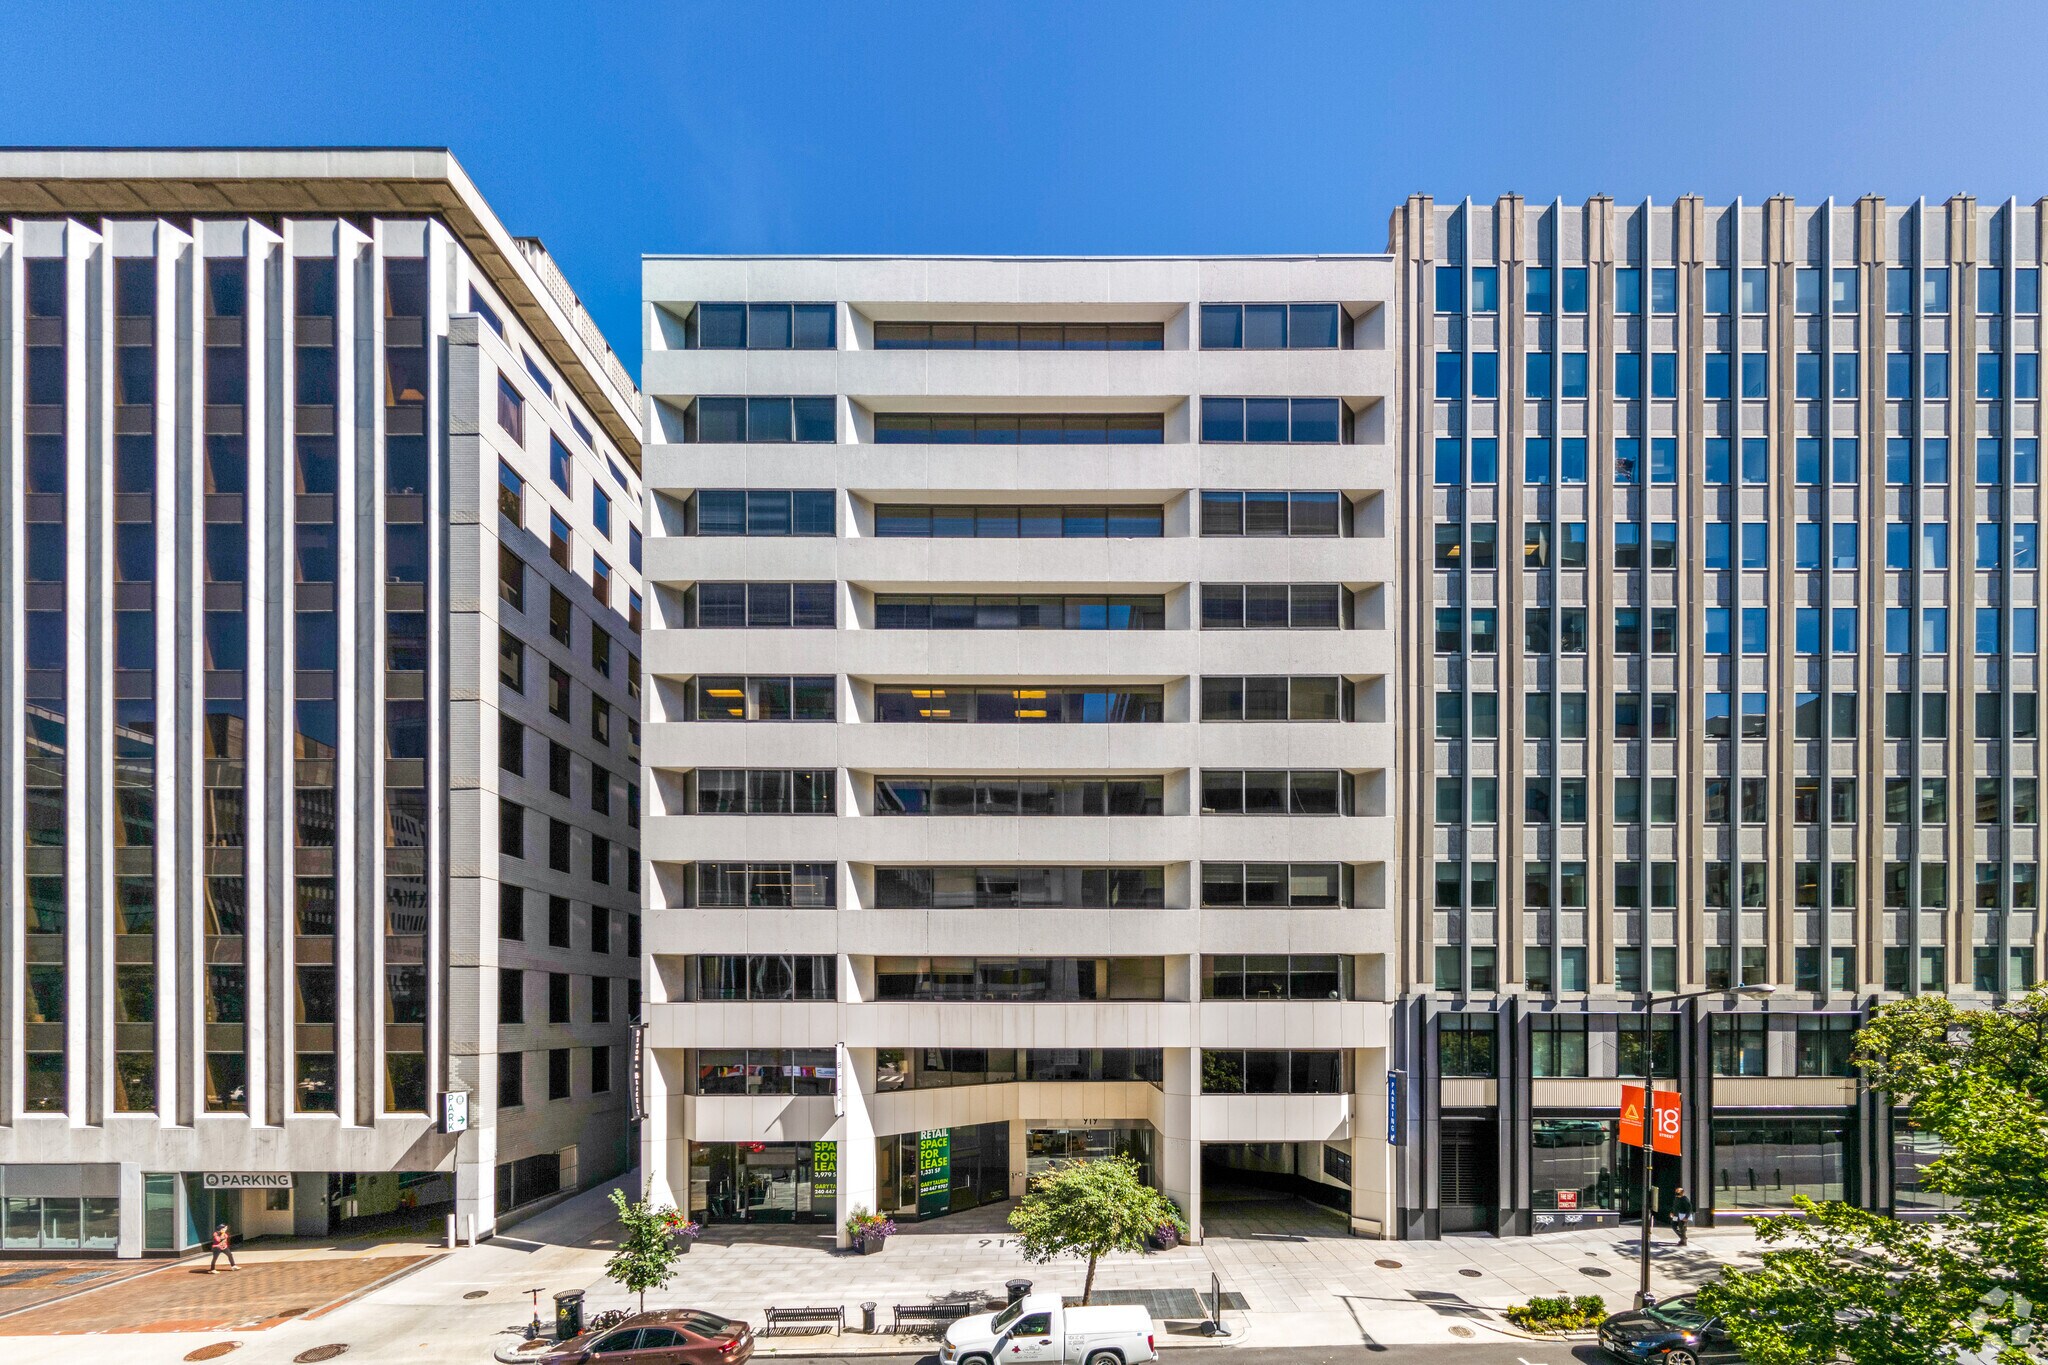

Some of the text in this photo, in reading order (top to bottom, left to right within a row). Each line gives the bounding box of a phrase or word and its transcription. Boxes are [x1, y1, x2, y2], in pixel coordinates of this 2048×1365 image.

[1654, 1108, 1679, 1134] 18
[920, 1128, 949, 1140] RETAIL
[920, 1138, 948, 1150] SPACE
[815, 1152, 837, 1161] FOR
[920, 1149, 939, 1160] FOR
[920, 1157, 948, 1170] LEASE
[221, 1175, 289, 1186] PARKING
